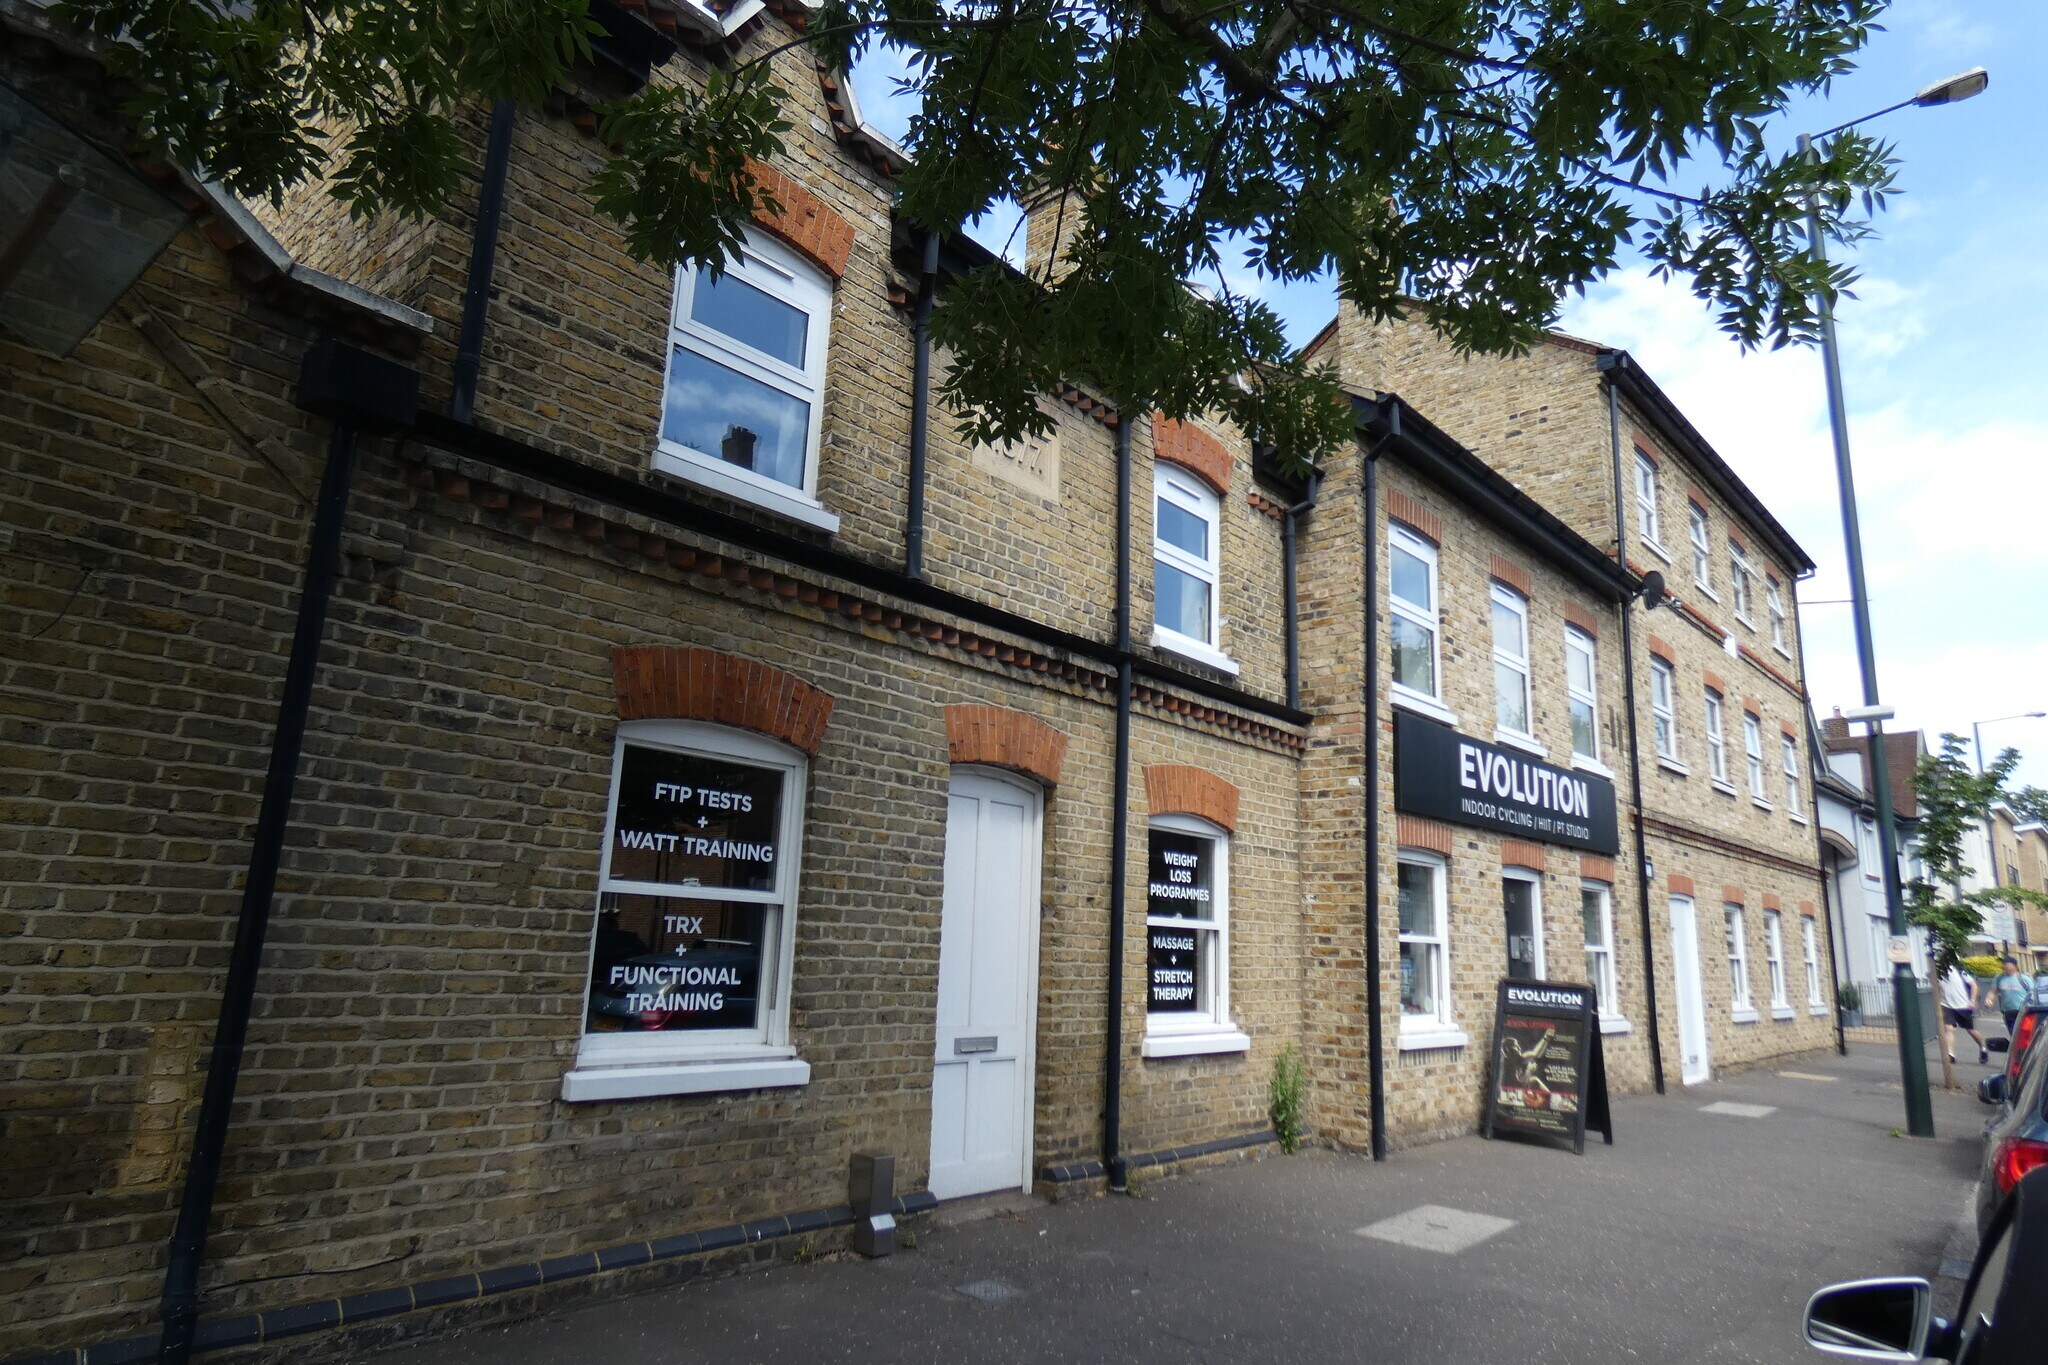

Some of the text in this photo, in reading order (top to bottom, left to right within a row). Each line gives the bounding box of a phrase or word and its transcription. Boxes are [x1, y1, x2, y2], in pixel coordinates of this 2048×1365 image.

[1459, 743, 1589, 818] EVOLUTION
[654, 782, 752, 812] FTP TESTS
[1461, 798, 1496, 819] INDOOR
[1498, 807, 1533, 828] CYCLING
[1538, 817, 1552, 832] HIIT
[1556, 820, 1565, 835] PT
[1565, 823, 1590, 840] STUDIO
[620, 829, 773, 863] WATT TRAINING
[1163, 851, 1198, 869] WEIGHT
[1169, 869, 1192, 884] LOSS
[1150, 883, 1210, 902] PROGRAMMES
[664, 915, 703, 934] TRX
[1153, 936, 1194, 951] MASSAGE
[610, 966, 741, 986] FUNCTIONAL
[1154, 970, 1193, 984] STRETCH
[625, 993, 724, 1012] TRAINING
[1153, 987, 1194, 1001] THERAPY
[1508, 988, 1583, 1006] EVOLUTION
